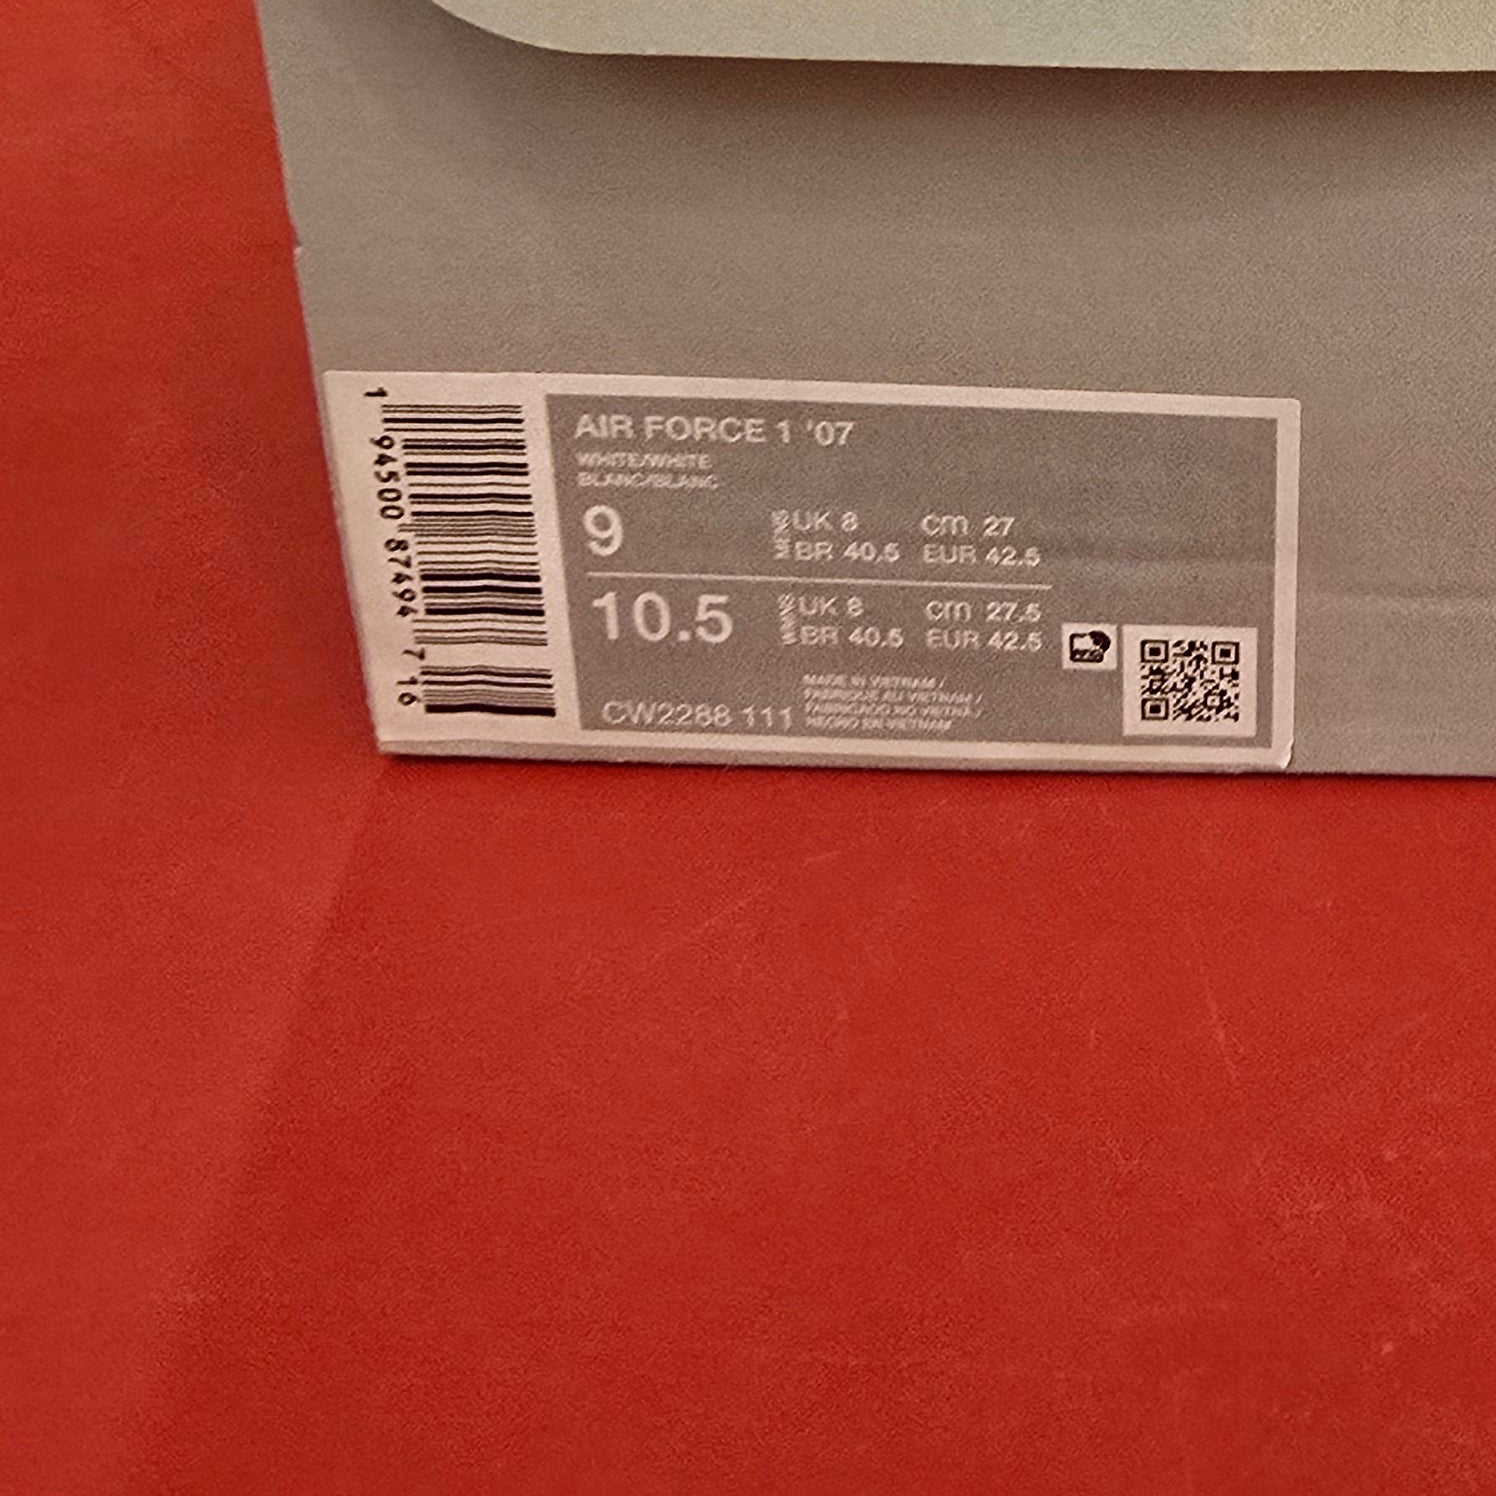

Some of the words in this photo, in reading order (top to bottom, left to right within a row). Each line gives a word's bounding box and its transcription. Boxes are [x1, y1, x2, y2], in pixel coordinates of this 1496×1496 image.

[574, 413, 634, 439] AIR
[644, 415, 767, 443] FORCE
[776, 418, 791, 444] 1
[806, 419, 855, 447] '07
[369, 435, 404, 520] 94500
[583, 504, 624, 556] 9
[792, 511, 833, 532] UK
[841, 511, 858, 532] 8
[921, 513, 968, 537] cm
[983, 515, 1015, 537] 27
[794, 541, 834, 562] BR
[844, 541, 900, 564] 40.5
[922, 543, 978, 565] EUR
[985, 545, 1041, 568] 42.5
[384, 538, 418, 618] 87494
[592, 591, 734, 644] 10.5
[799, 595, 840, 617] UK
[847, 596, 864, 618] 8
[925, 600, 972, 622] cm
[985, 601, 1042, 624] 27.5
[801, 625, 840, 646] BR
[849, 626, 904, 649] 40.5
[925, 628, 981, 651] EUR
[987, 630, 1043, 653] 42.5
[602, 700, 733, 728] CW2288
[742, 705, 793, 732] 111
